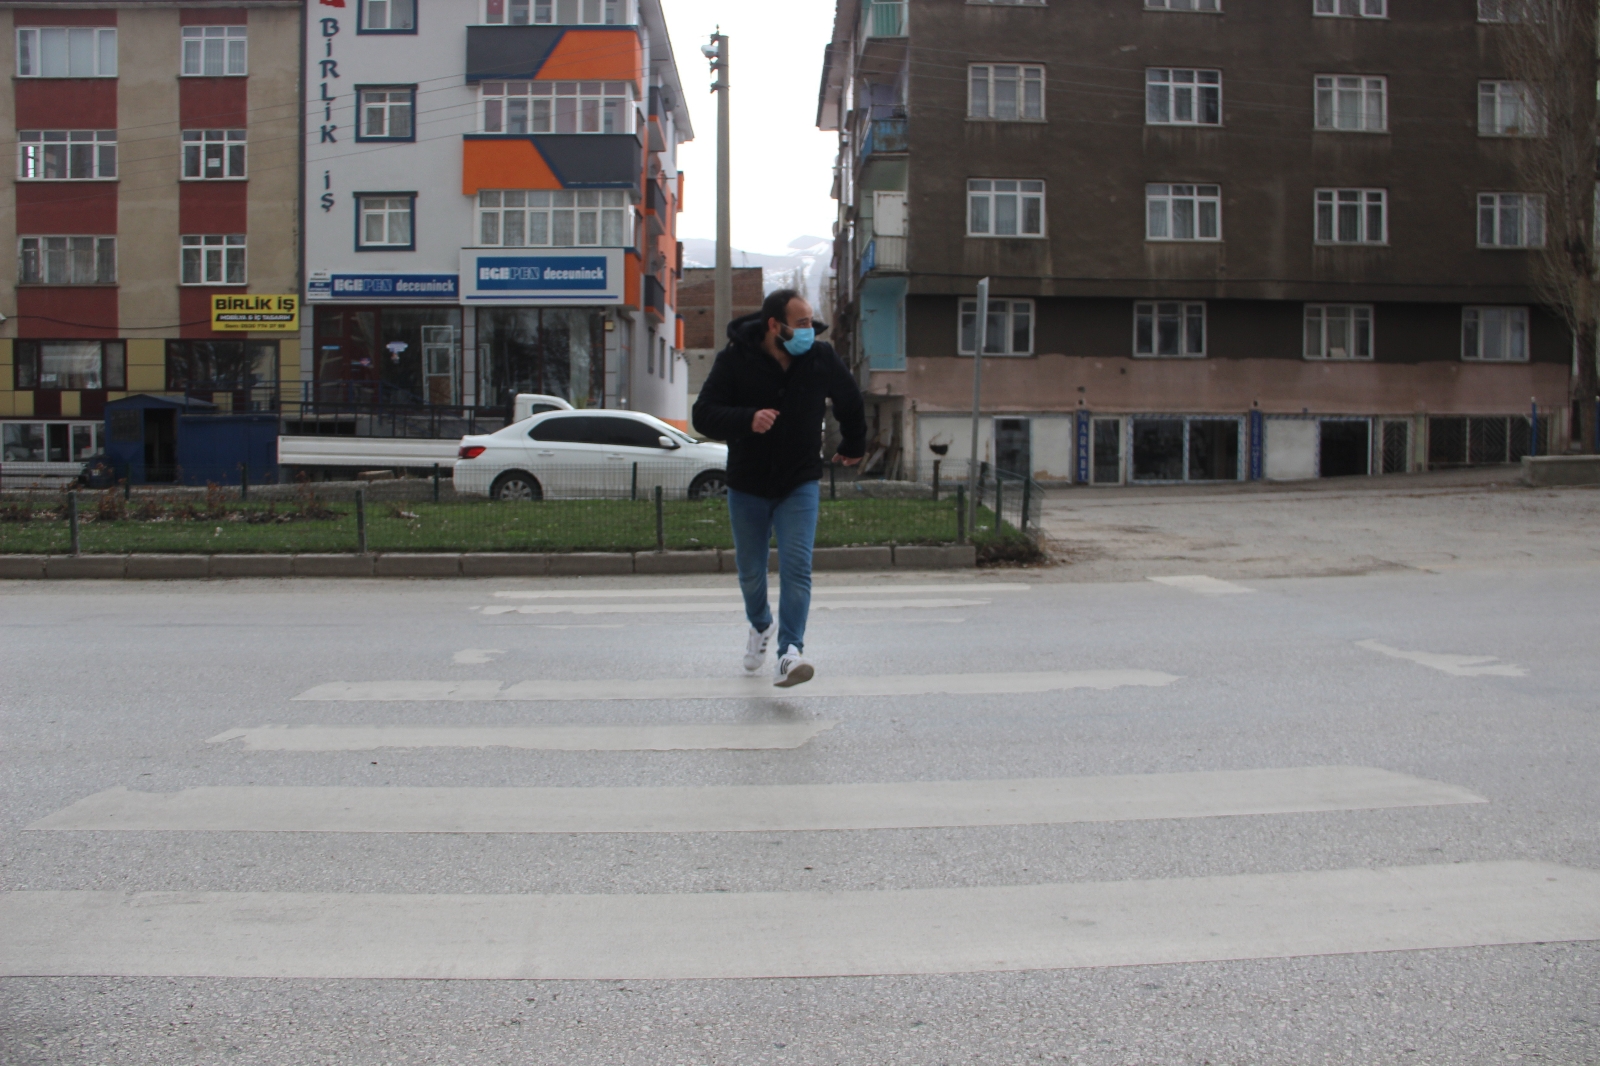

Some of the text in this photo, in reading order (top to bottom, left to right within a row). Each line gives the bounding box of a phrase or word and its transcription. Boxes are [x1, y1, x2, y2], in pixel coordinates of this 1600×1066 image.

[319, 17, 340, 213] BİRLİK İŞ
[479, 266, 604, 280] EGEPEN deceuninck
[334, 279, 455, 292] EGEPEN deceuninck
[216, 296, 295, 312] BİRLİK İŞ
